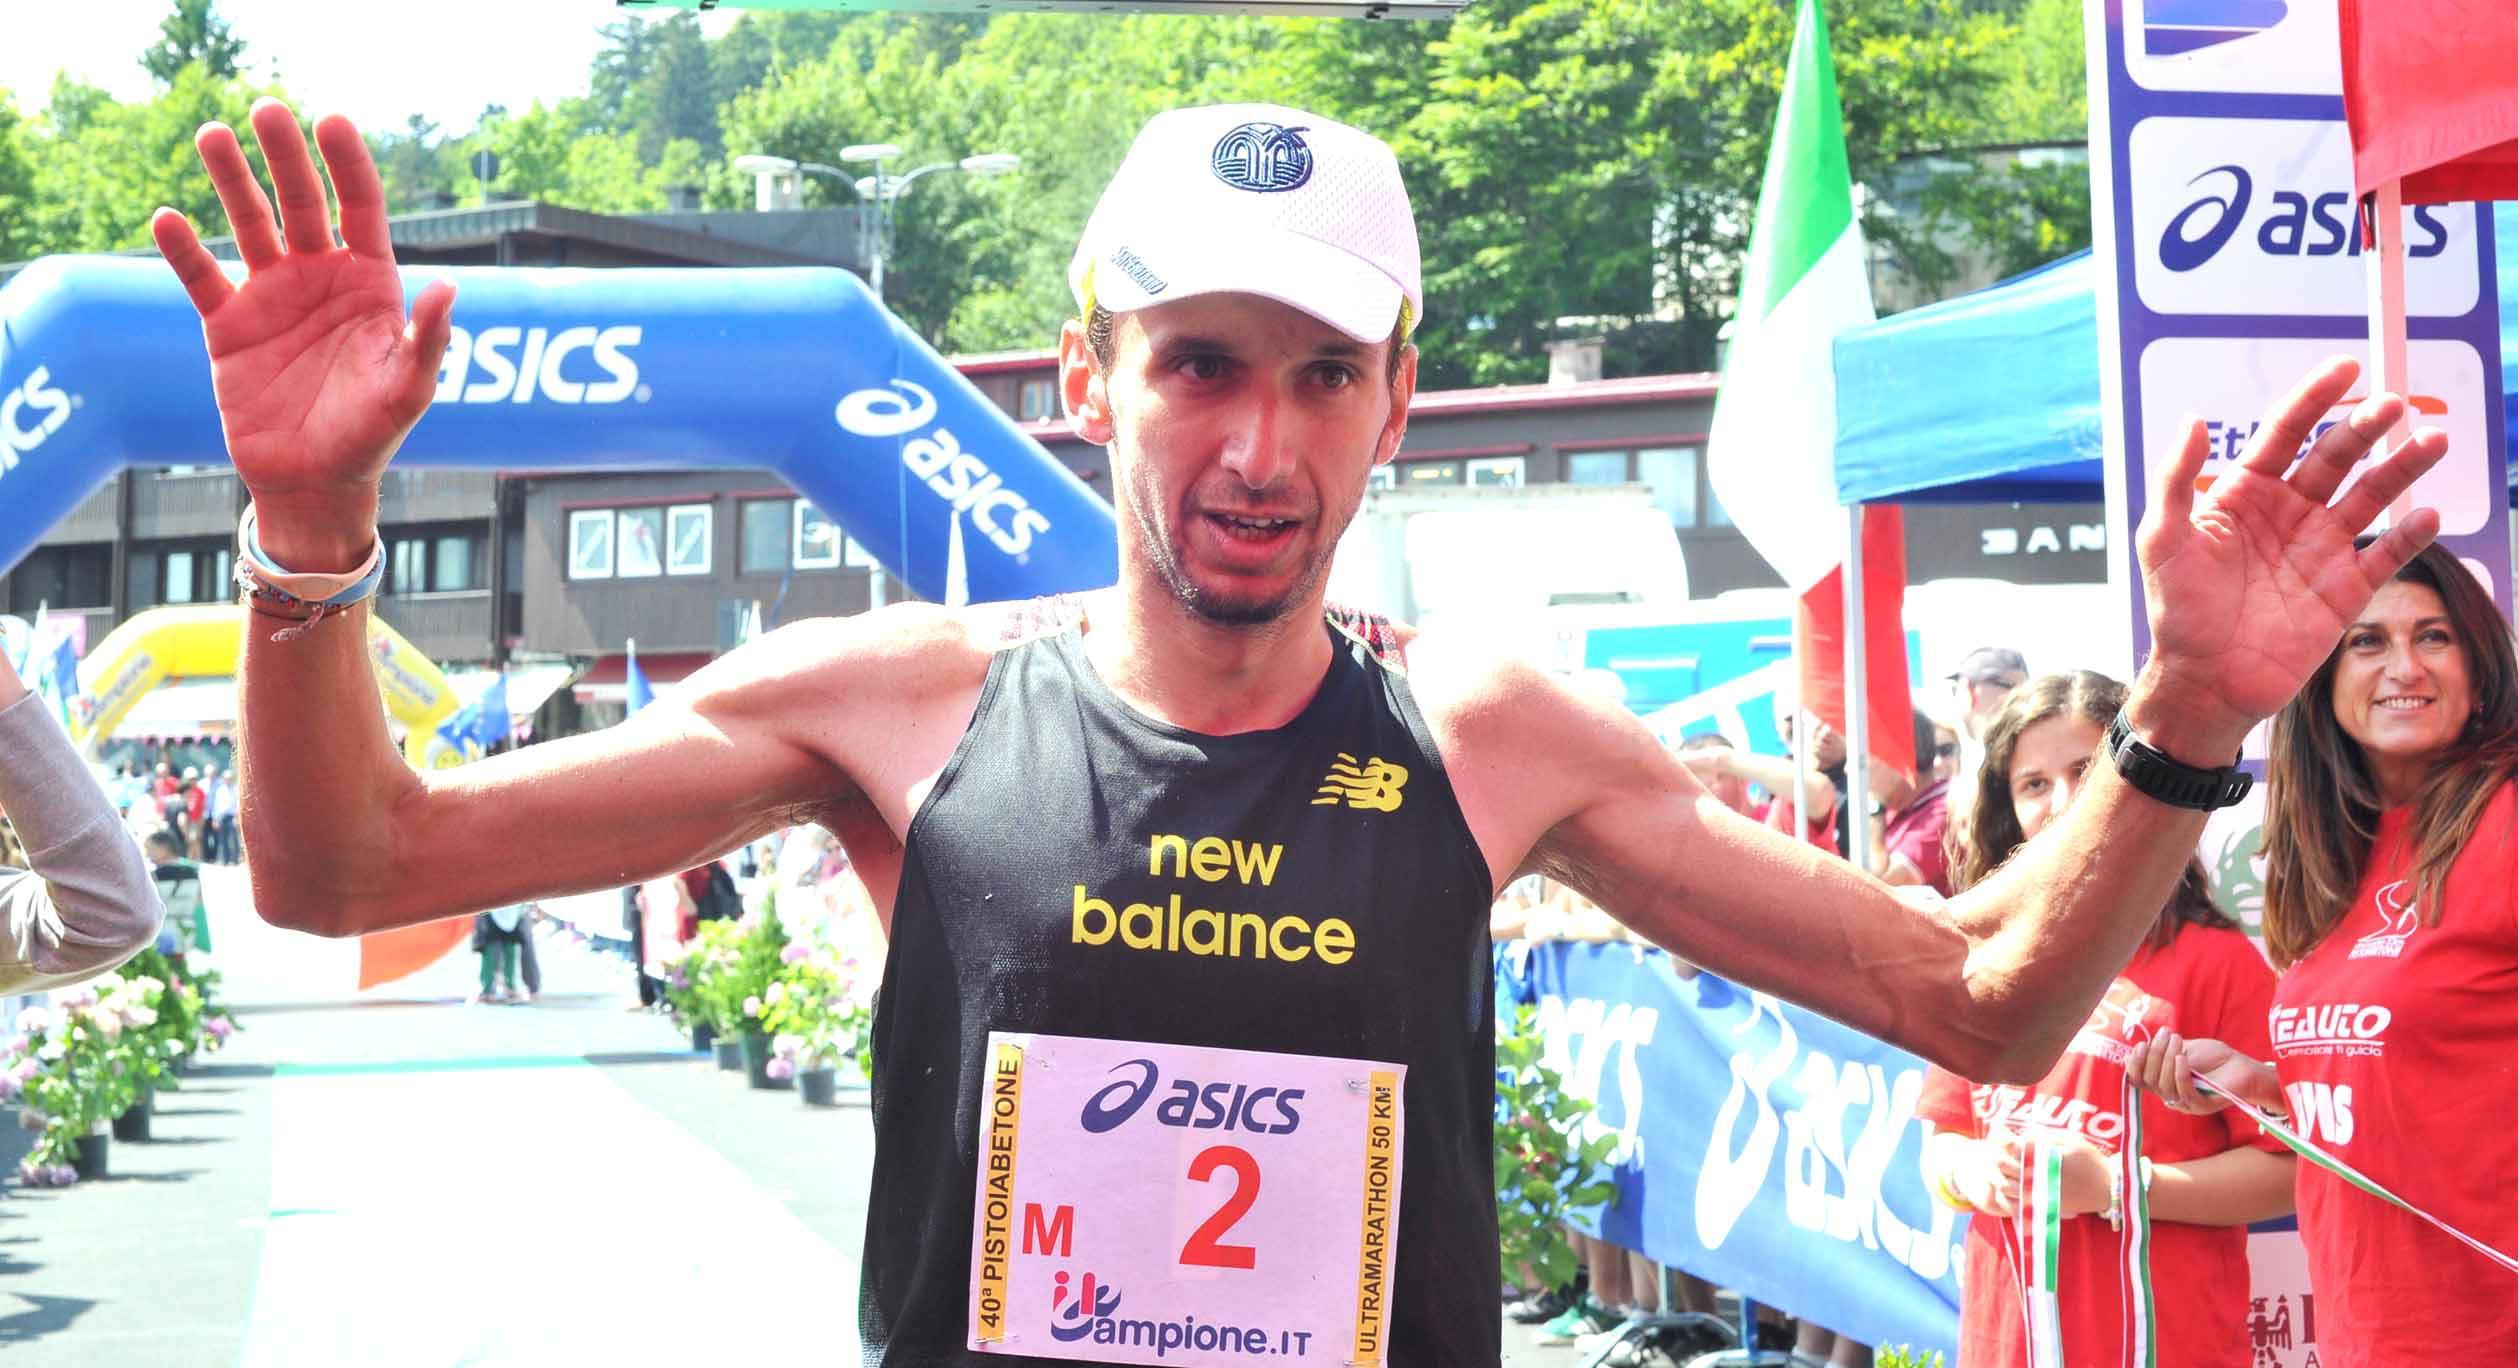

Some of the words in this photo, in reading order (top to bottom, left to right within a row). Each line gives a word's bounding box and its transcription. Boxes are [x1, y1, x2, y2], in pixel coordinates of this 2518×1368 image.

[902, 427, 1051, 555] asics
[1149, 833, 1284, 887] new
[1071, 884, 1356, 965] balance
[1157, 1080, 1305, 1134] asics
[1374, 1086, 1392, 1119] KM
[983, 1058, 1018, 1281] PISTOIABETONE
[1372, 1126, 1391, 1149] 50
[1021, 1202, 1075, 1258] M
[1179, 1145, 1261, 1270] 2
[1359, 1155, 1389, 1353] ULTRAMARATHON
